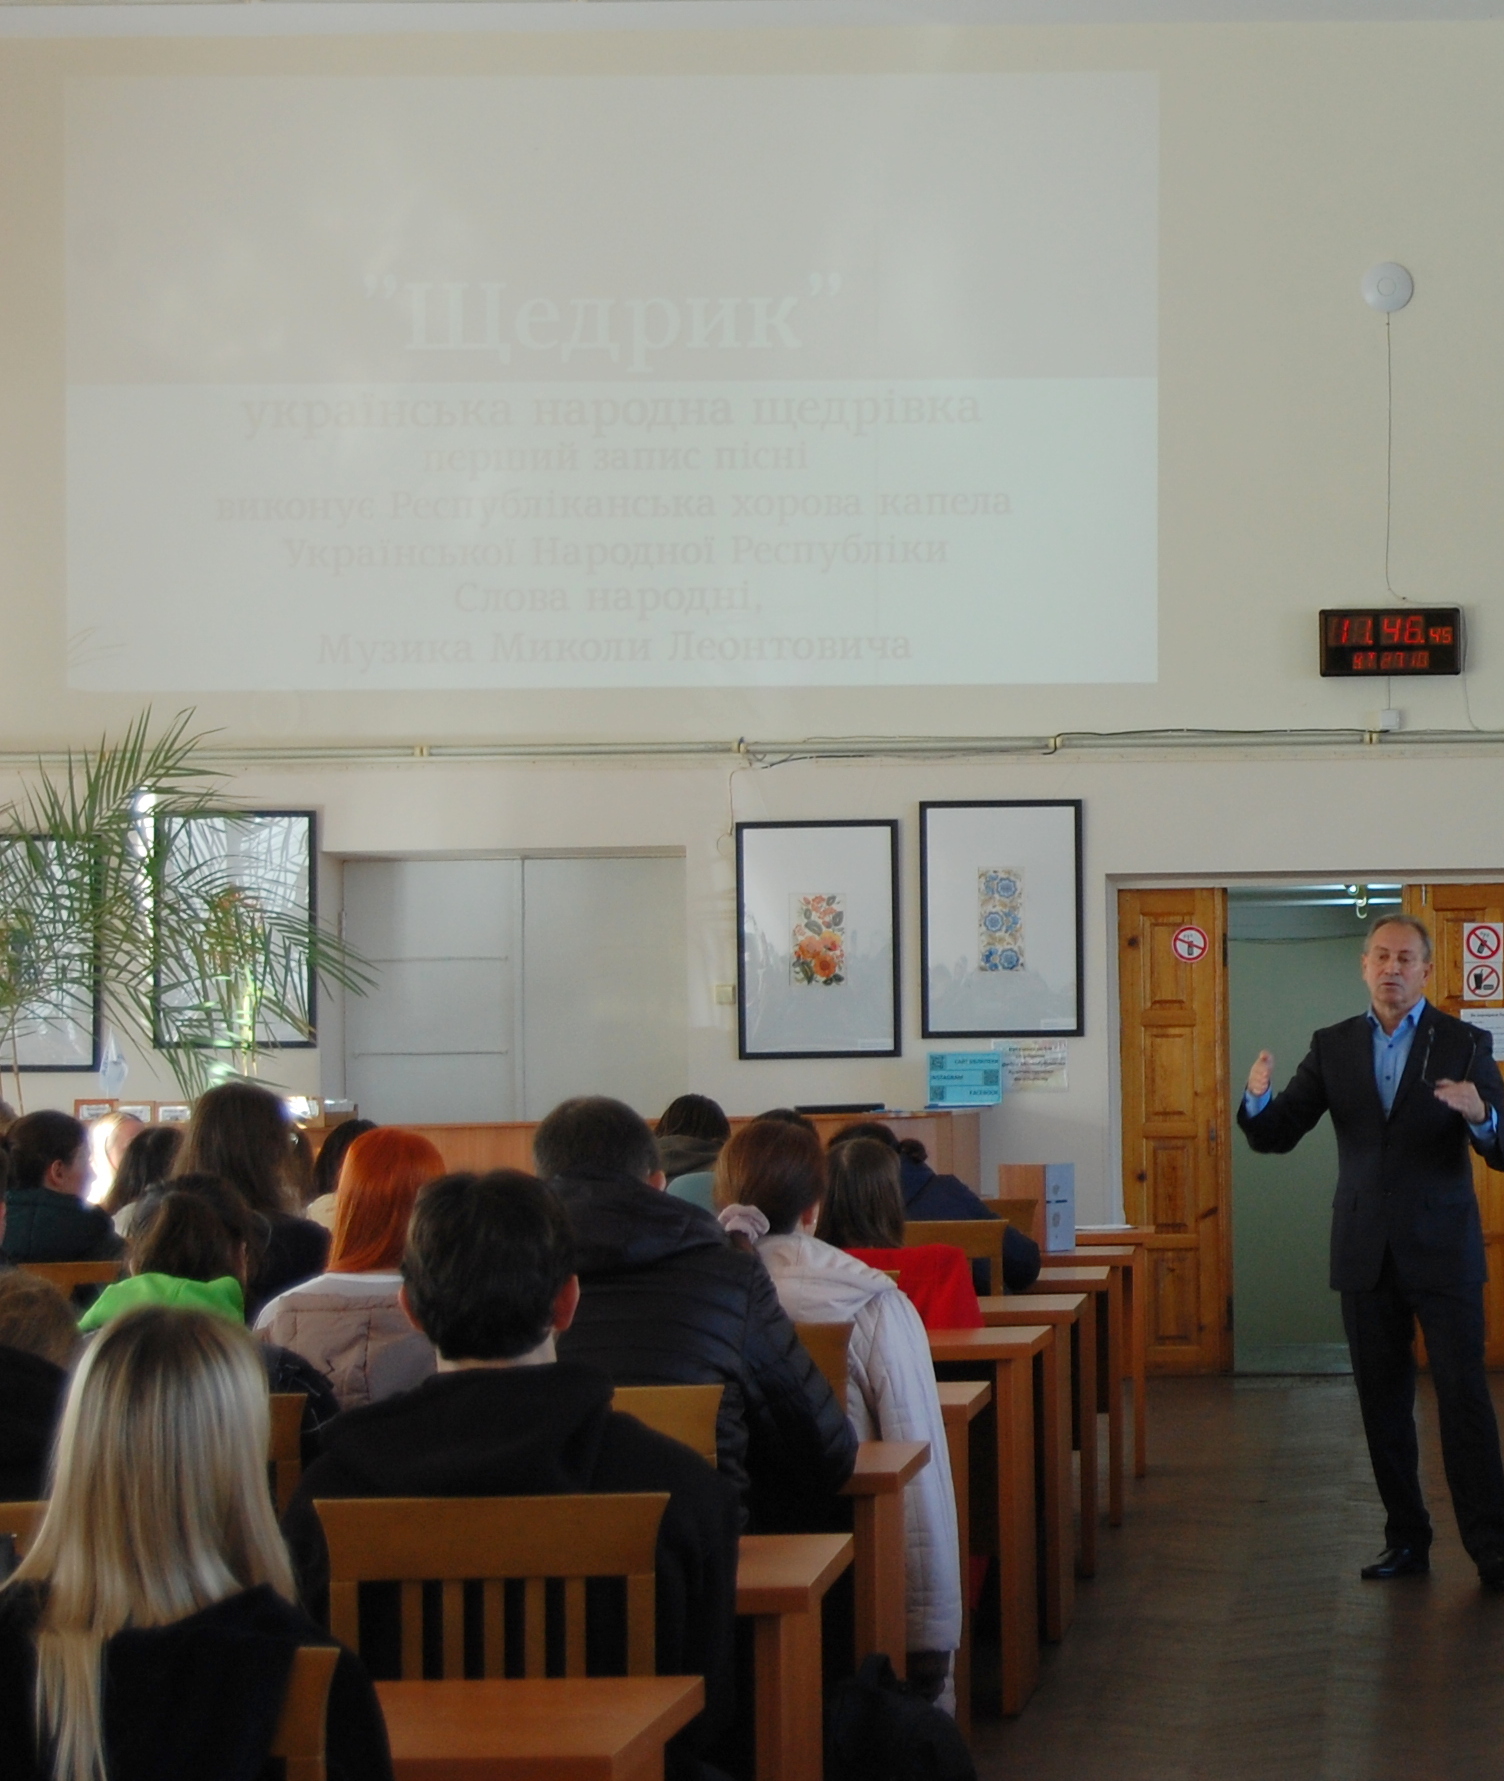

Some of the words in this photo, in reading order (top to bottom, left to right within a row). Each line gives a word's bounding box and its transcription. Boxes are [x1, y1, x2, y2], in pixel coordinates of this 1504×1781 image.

[242, 392, 514, 440] українська
[533, 395, 735, 439] народна
[752, 388, 982, 437] щедрівка
[423, 441, 581, 481] перший
[592, 444, 702, 471] запис
[715, 440, 808, 470] пісні
[215, 494, 375, 530] виконує
[390, 486, 716, 529] Республіканська
[731, 492, 863, 527] хорова
[878, 490, 1013, 517] капела
[282, 536, 518, 577] Української
[532, 536, 716, 576] Народної
[731, 533, 949, 574] Республіки
[454, 581, 570, 613] Слова
[587, 580, 763, 622] народні,
[316, 632, 476, 675] Музика
[489, 631, 653, 663] Миколи
[667, 630, 913, 663] Леонтовича
